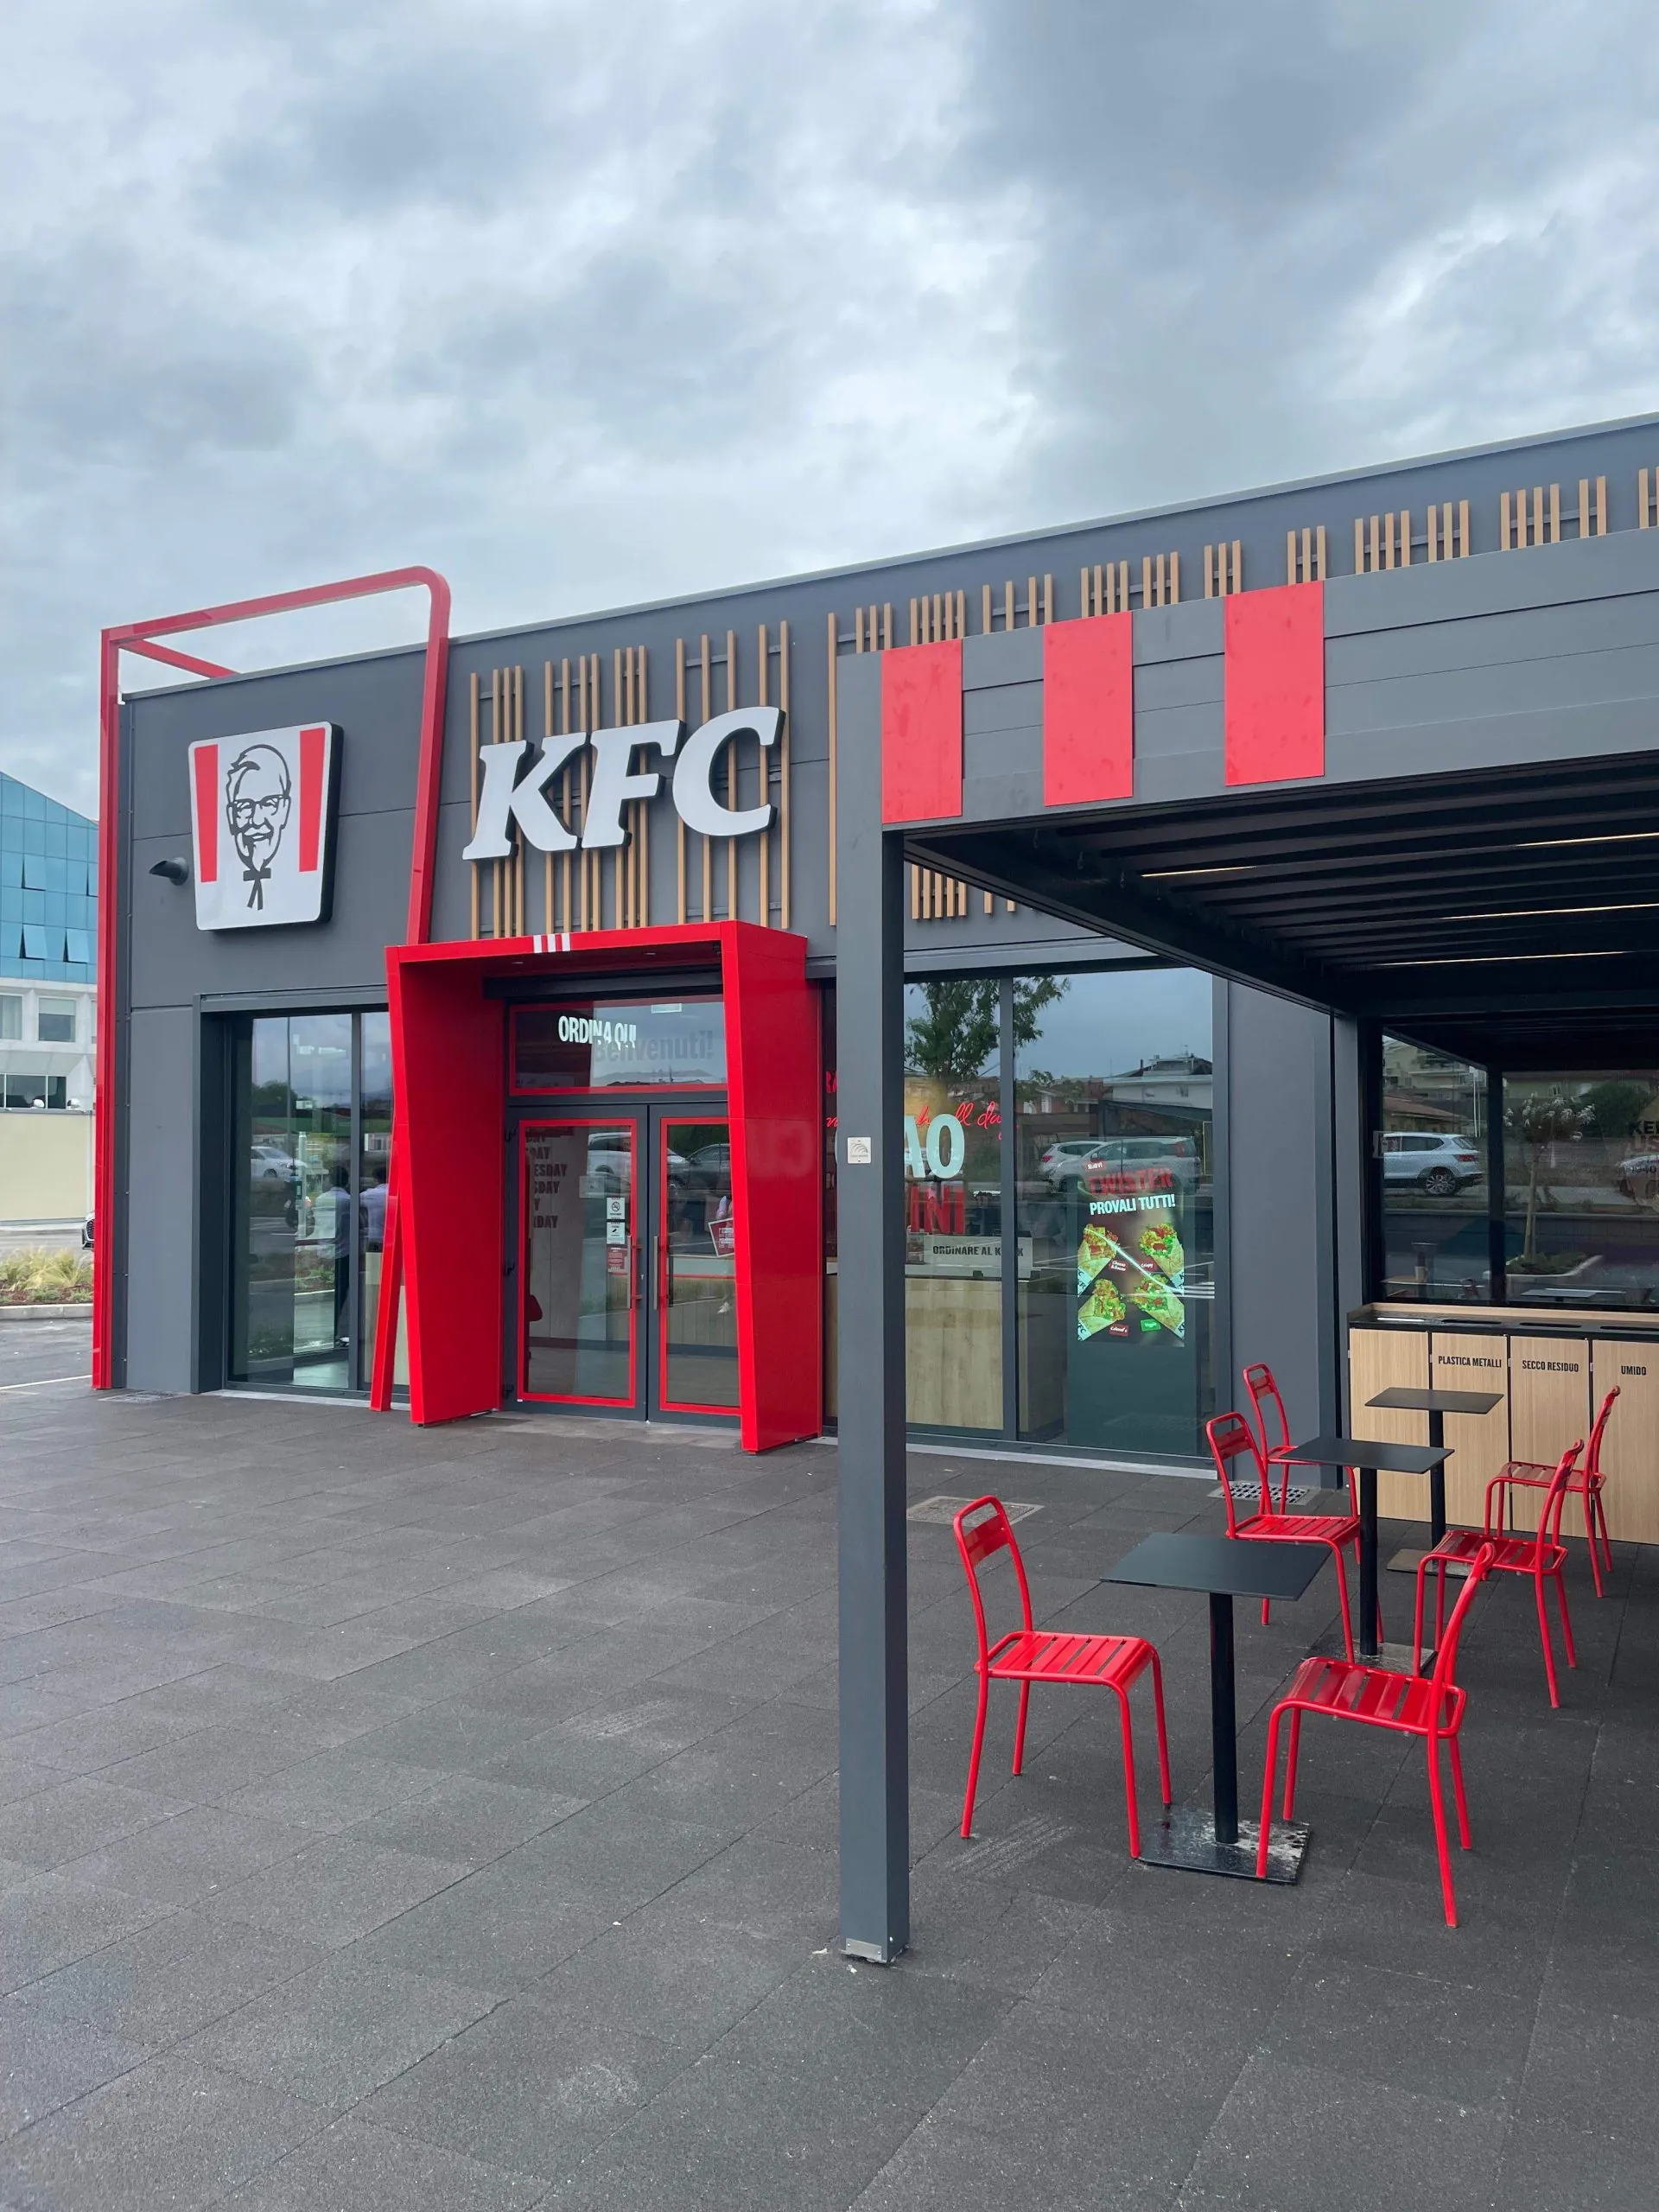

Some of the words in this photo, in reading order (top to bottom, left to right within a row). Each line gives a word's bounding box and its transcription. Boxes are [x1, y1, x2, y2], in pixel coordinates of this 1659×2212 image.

[462, 706, 785, 861] KFC
[1090, 1198, 1137, 1216] PROVALI
[1138, 1193, 1176, 1211] TUTTI!
[932, 1245, 979, 1255] ORDINARE
[981, 1246, 993, 1255] AL
[1438, 1355, 1471, 1367] PLASTICA
[1471, 1357, 1503, 1369] METALLI
[1522, 1360, 1547, 1371] SECCO
[1547, 1361, 1580, 1373] RESIDUO
[1620, 1364, 1647, 1376] UMIDO
